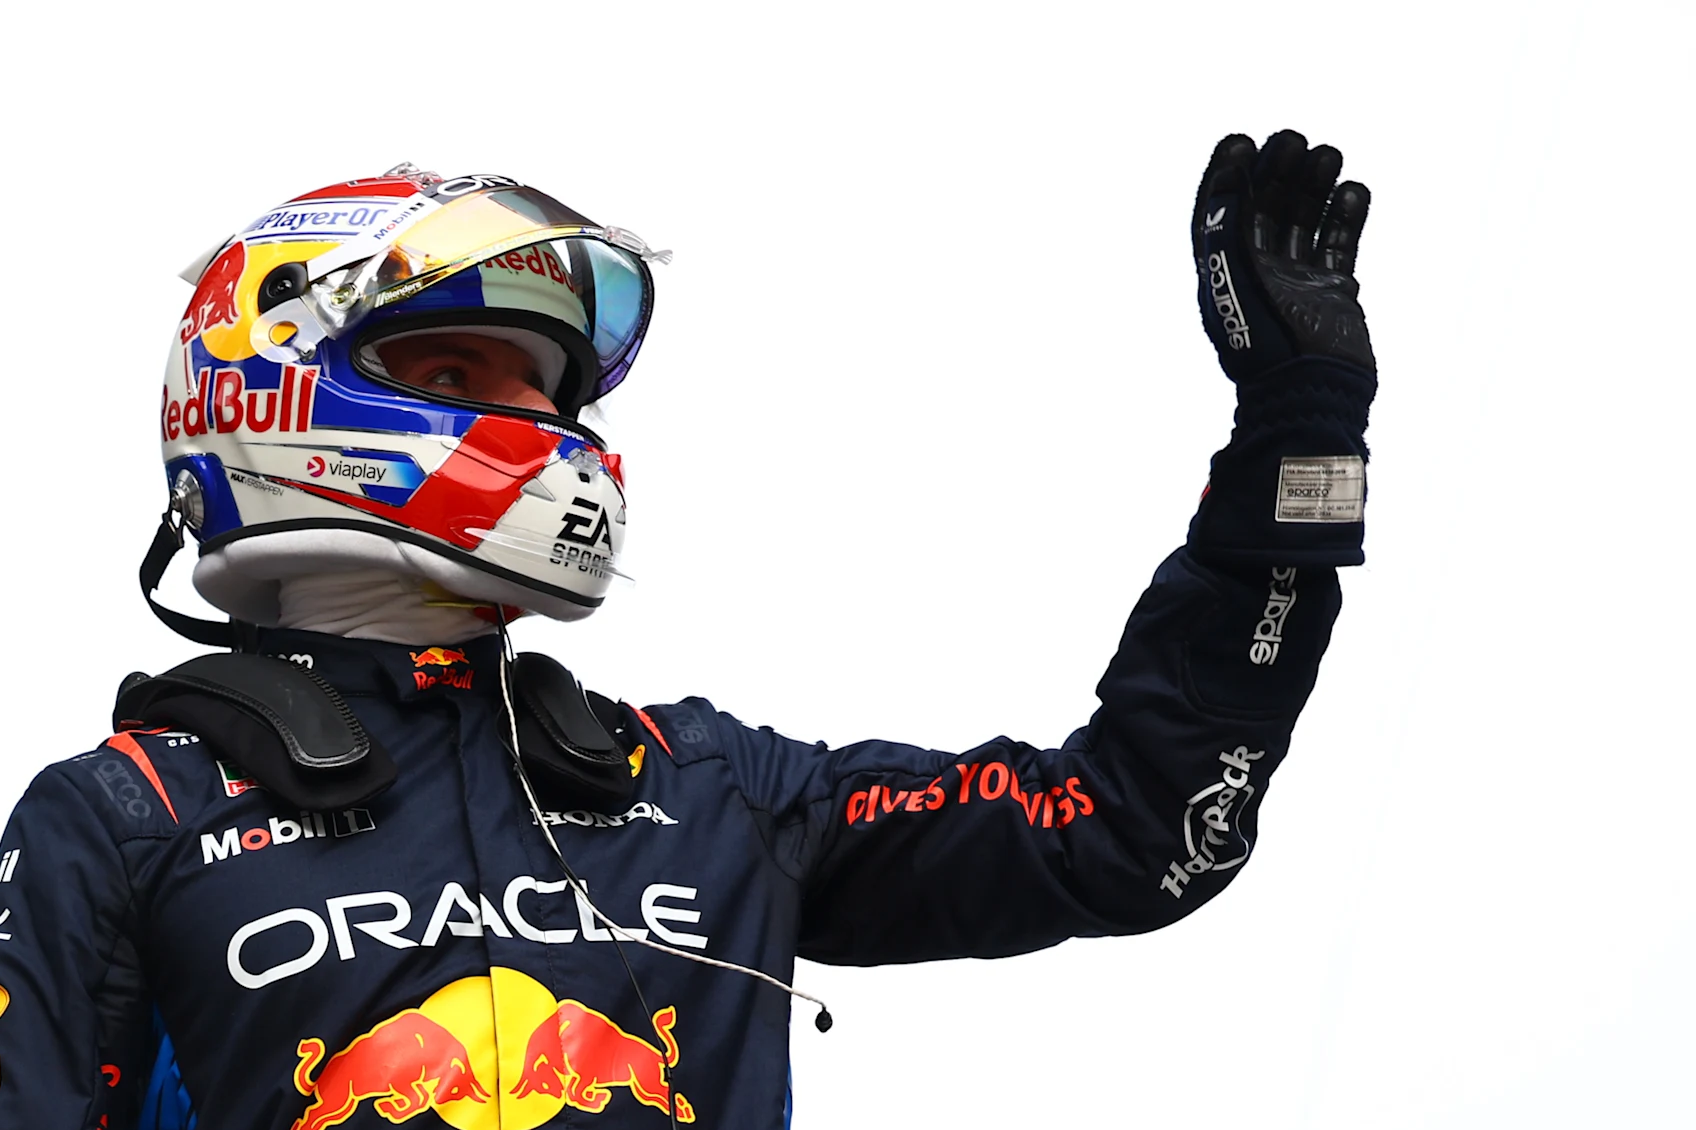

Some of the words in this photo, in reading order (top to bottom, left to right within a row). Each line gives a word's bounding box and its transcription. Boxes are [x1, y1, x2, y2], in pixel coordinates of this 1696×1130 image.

[373, 210, 412, 240] Mobil
[1208, 253, 1251, 350] sparco
[162, 370, 209, 442] Red
[215, 365, 319, 434] Bull
[537, 421, 585, 442] VERSTAPPEN
[329, 460, 387, 482] viaplay
[557, 497, 614, 556] EA
[412, 671, 443, 691] Re
[530, 802, 679, 828] HONDA
[1202, 745, 1266, 832] Rock
[200, 811, 327, 865] Mobil
[227, 875, 708, 990] ORACLE
